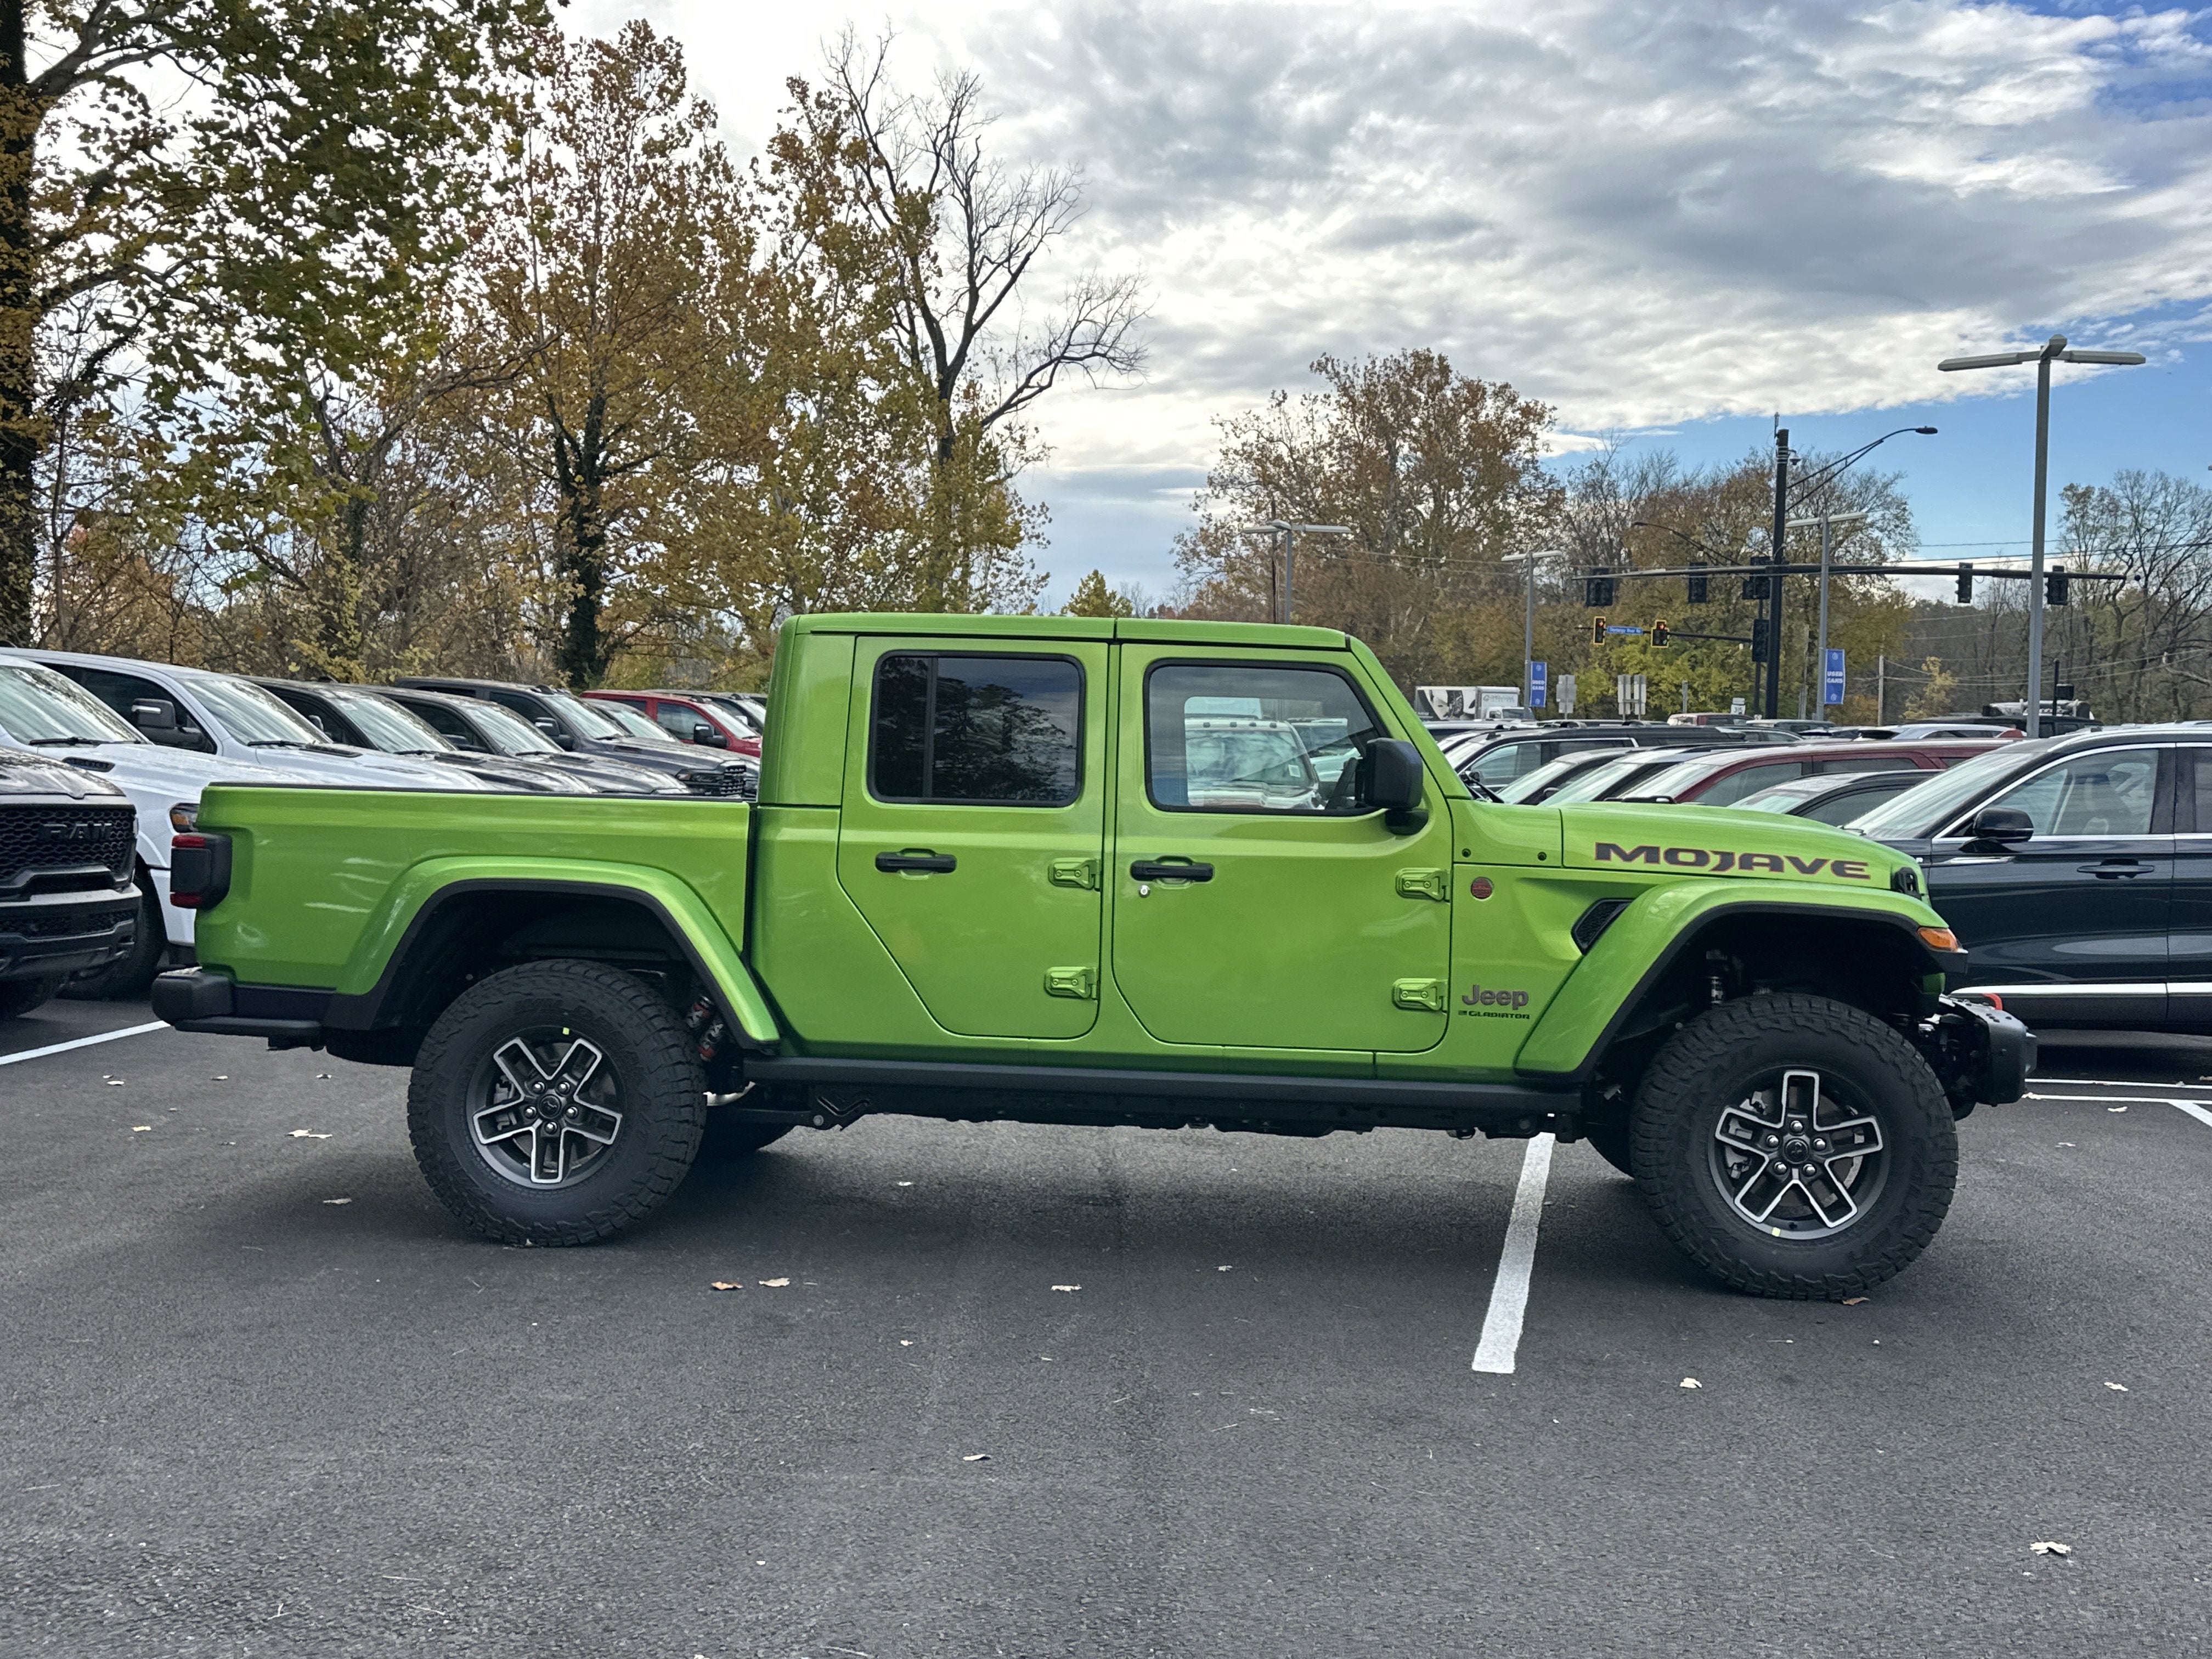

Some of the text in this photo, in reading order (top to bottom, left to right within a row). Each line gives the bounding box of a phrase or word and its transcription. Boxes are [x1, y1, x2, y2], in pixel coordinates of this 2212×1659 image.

[1594, 842, 1871, 879] MOJAVE
[1462, 985, 1530, 1010] Jeep
[1468, 1011, 1530, 1019] GLADIATOR
